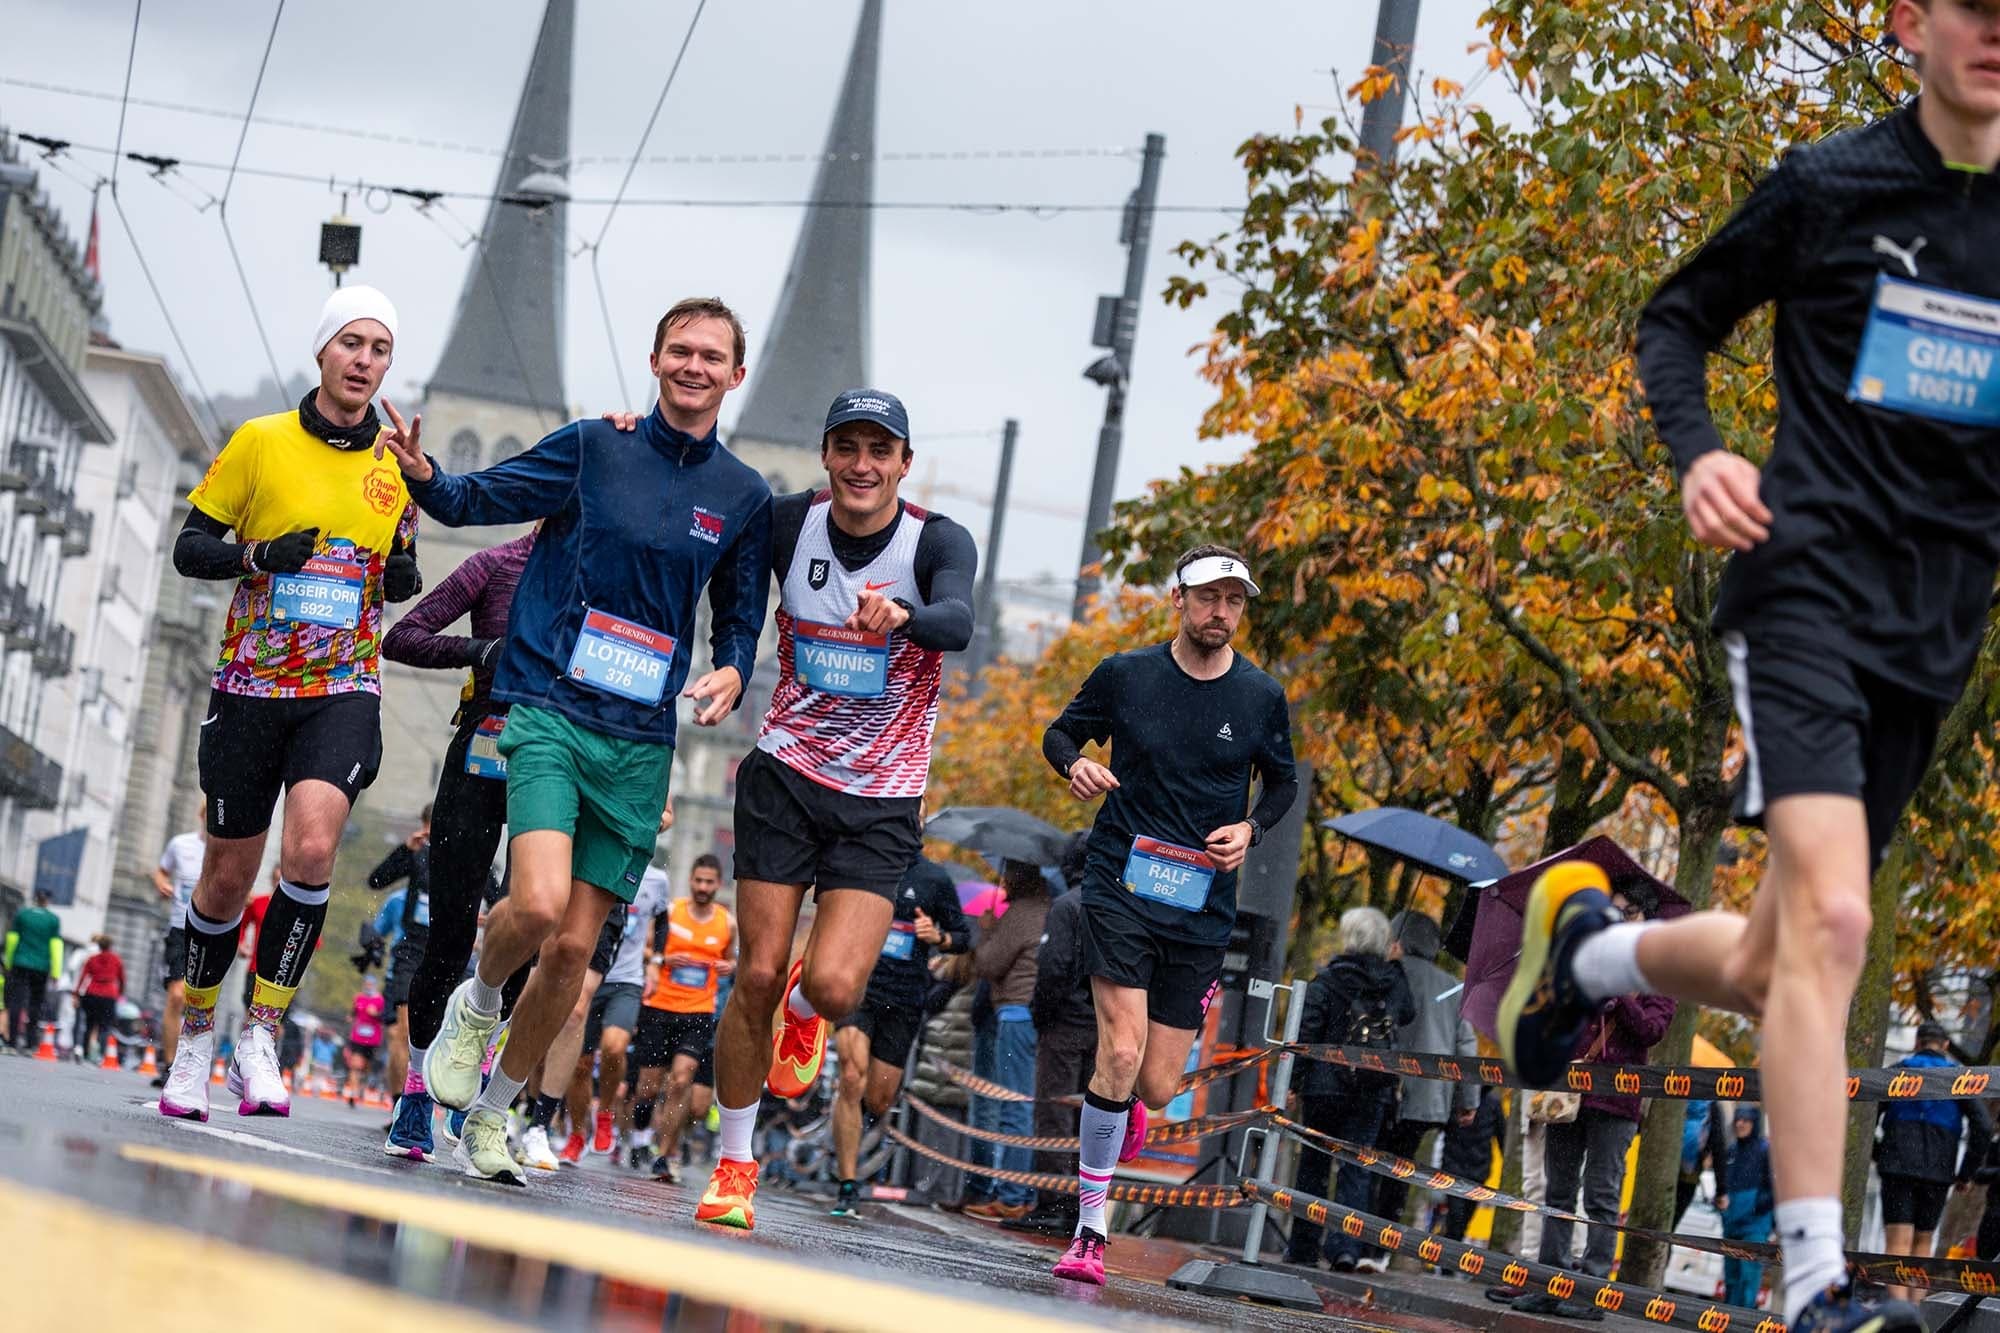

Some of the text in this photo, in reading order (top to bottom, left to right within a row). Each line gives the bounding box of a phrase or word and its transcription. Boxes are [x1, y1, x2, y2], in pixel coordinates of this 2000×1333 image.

[1907, 337, 1993, 380] GIAN
[371, 478, 397, 493] Chupa
[310, 562, 344, 574] GENERALI
[276, 582, 359, 604] ASGEIR ORN
[300, 601, 334, 617] 5922
[622, 627, 655, 644] GENERALI
[827, 630, 864, 642] GENERALI
[587, 639, 660, 679] LOTHAR
[804, 647, 876, 673] YANNIS
[606, 667, 633, 687] 376
[823, 671, 850, 686] 418
[1165, 847, 1197, 862] GENERALI
[1148, 864, 1192, 885] RALF
[1153, 882, 1177, 897] 862
